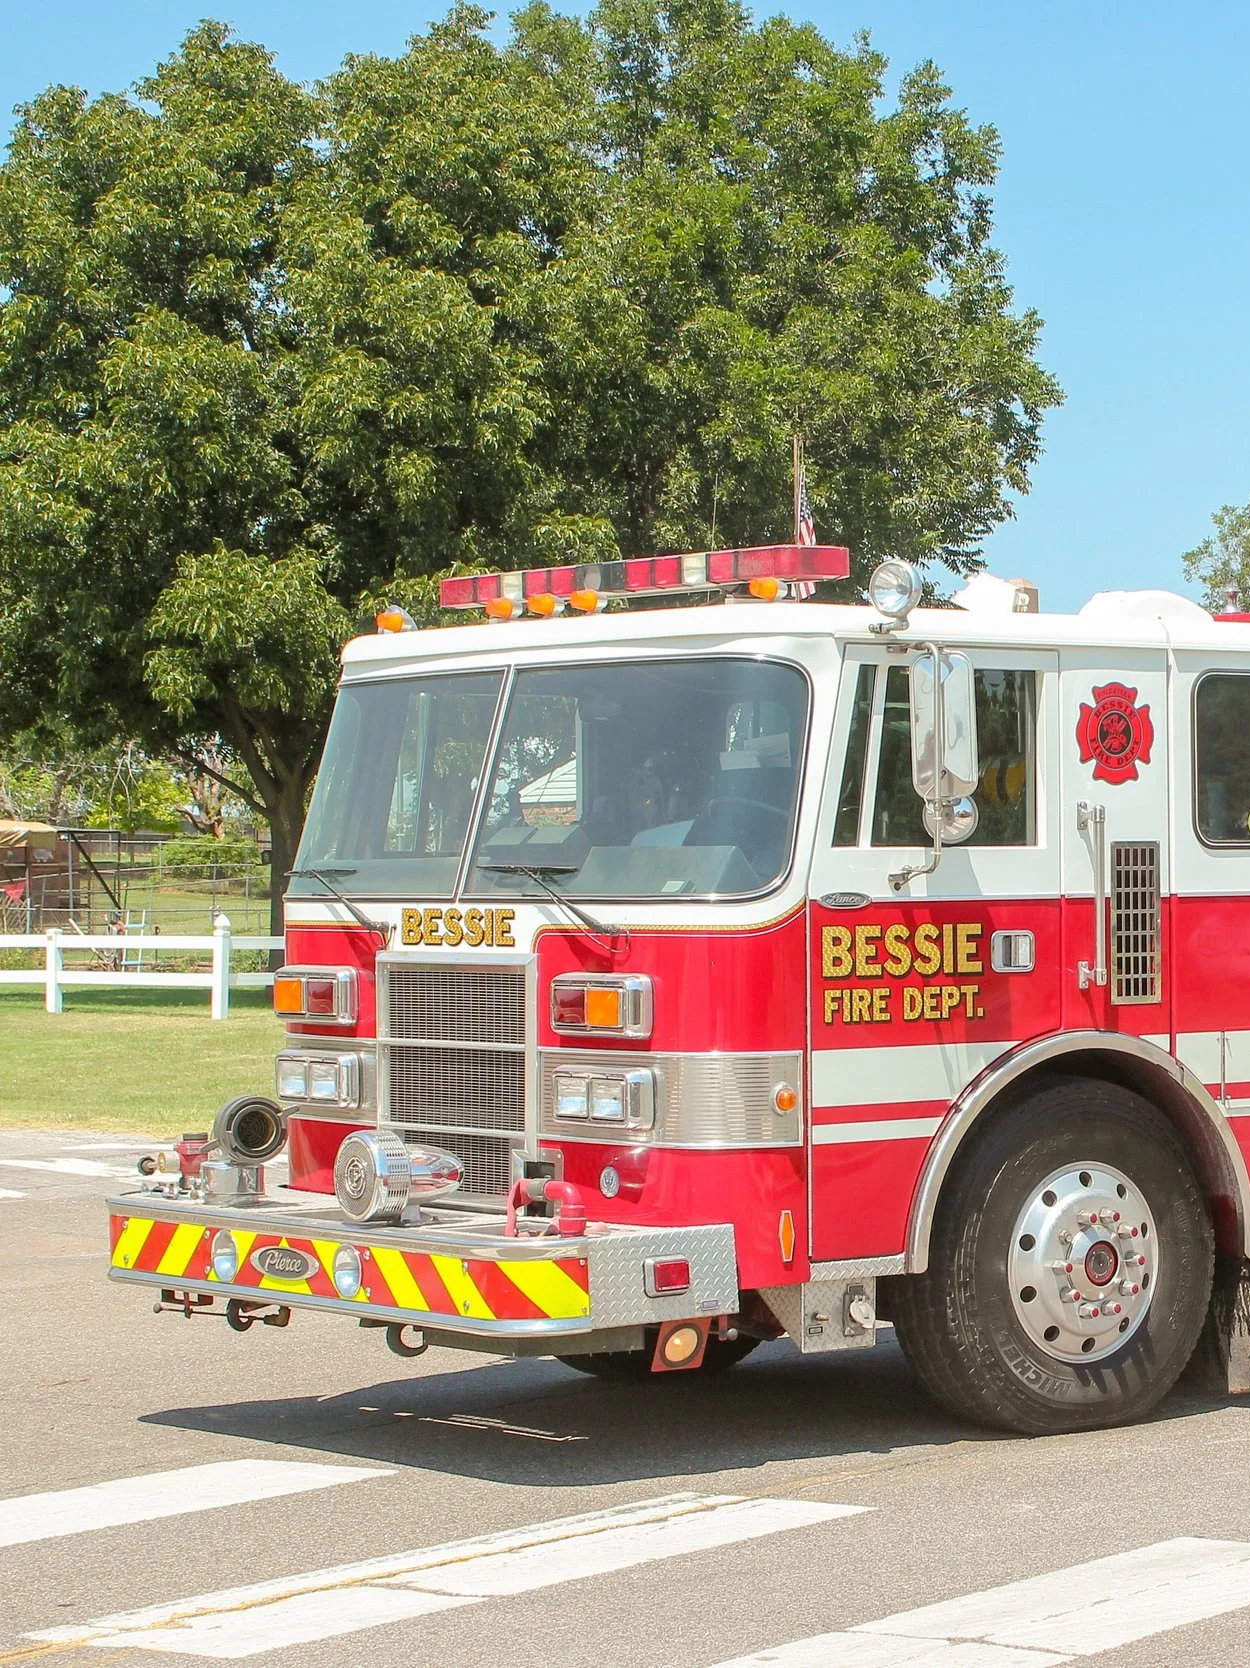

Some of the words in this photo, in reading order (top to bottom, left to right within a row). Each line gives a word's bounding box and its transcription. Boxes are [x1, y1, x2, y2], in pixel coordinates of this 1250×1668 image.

[1095, 701, 1137, 719] BESSIE
[1090, 738, 1112, 765] FIRE
[1117, 738, 1140, 765] DEPT
[401, 907, 515, 947] BESSIE
[821, 923, 984, 979] BESSIE
[824, 987, 892, 1025] FIRE
[903, 984, 985, 1021] DEPT.
[264, 1249, 302, 1273] Pierce
